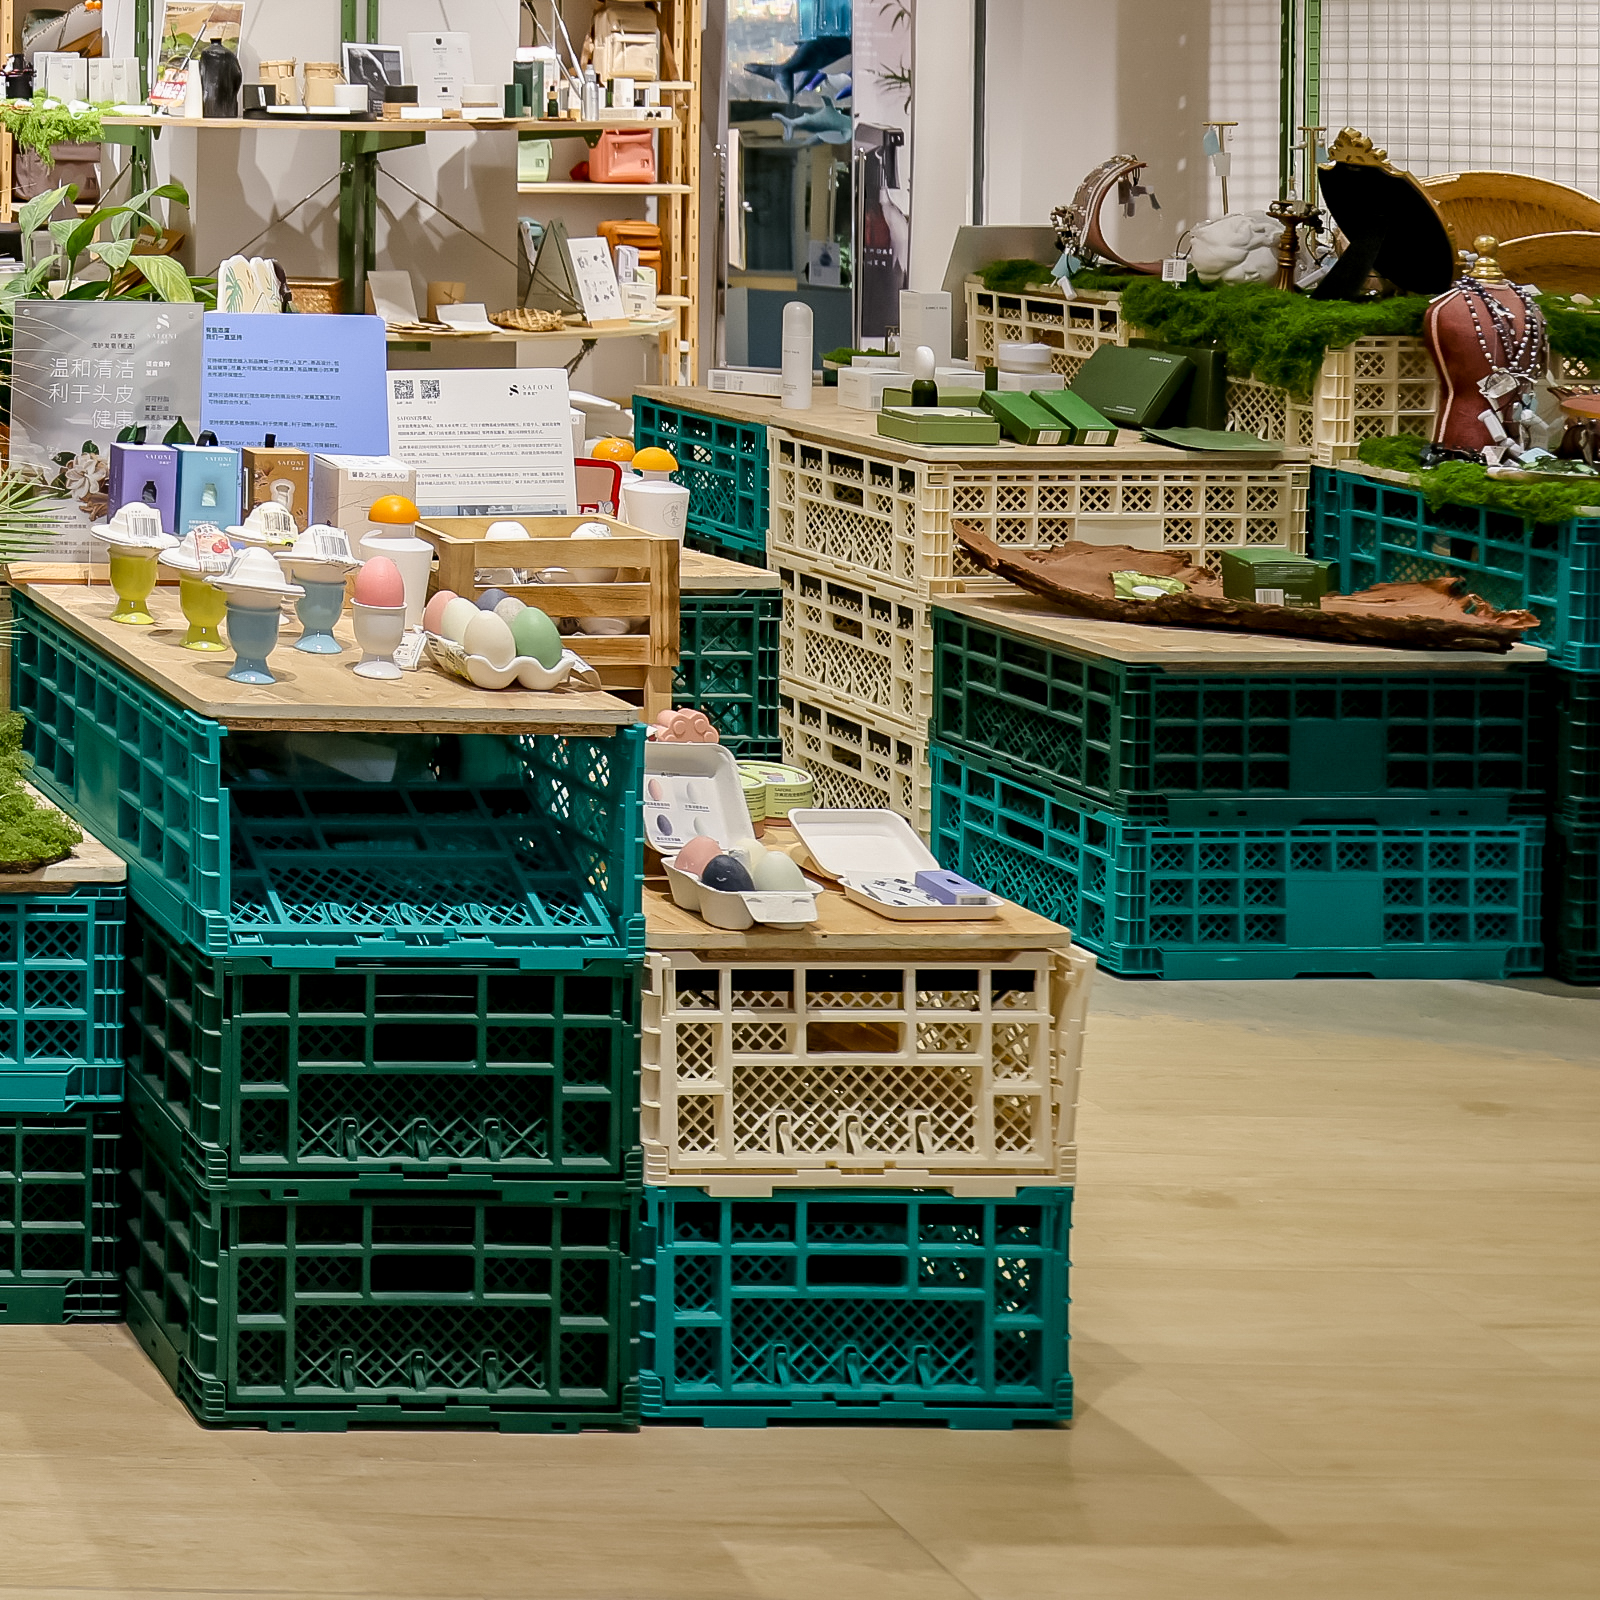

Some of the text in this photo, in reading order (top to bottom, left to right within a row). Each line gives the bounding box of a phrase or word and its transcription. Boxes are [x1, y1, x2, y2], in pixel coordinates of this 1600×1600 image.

[49, 357, 135, 379] 温和清洁
[49, 383, 135, 405] 利于头皮
[91, 409, 135, 429] 健康
